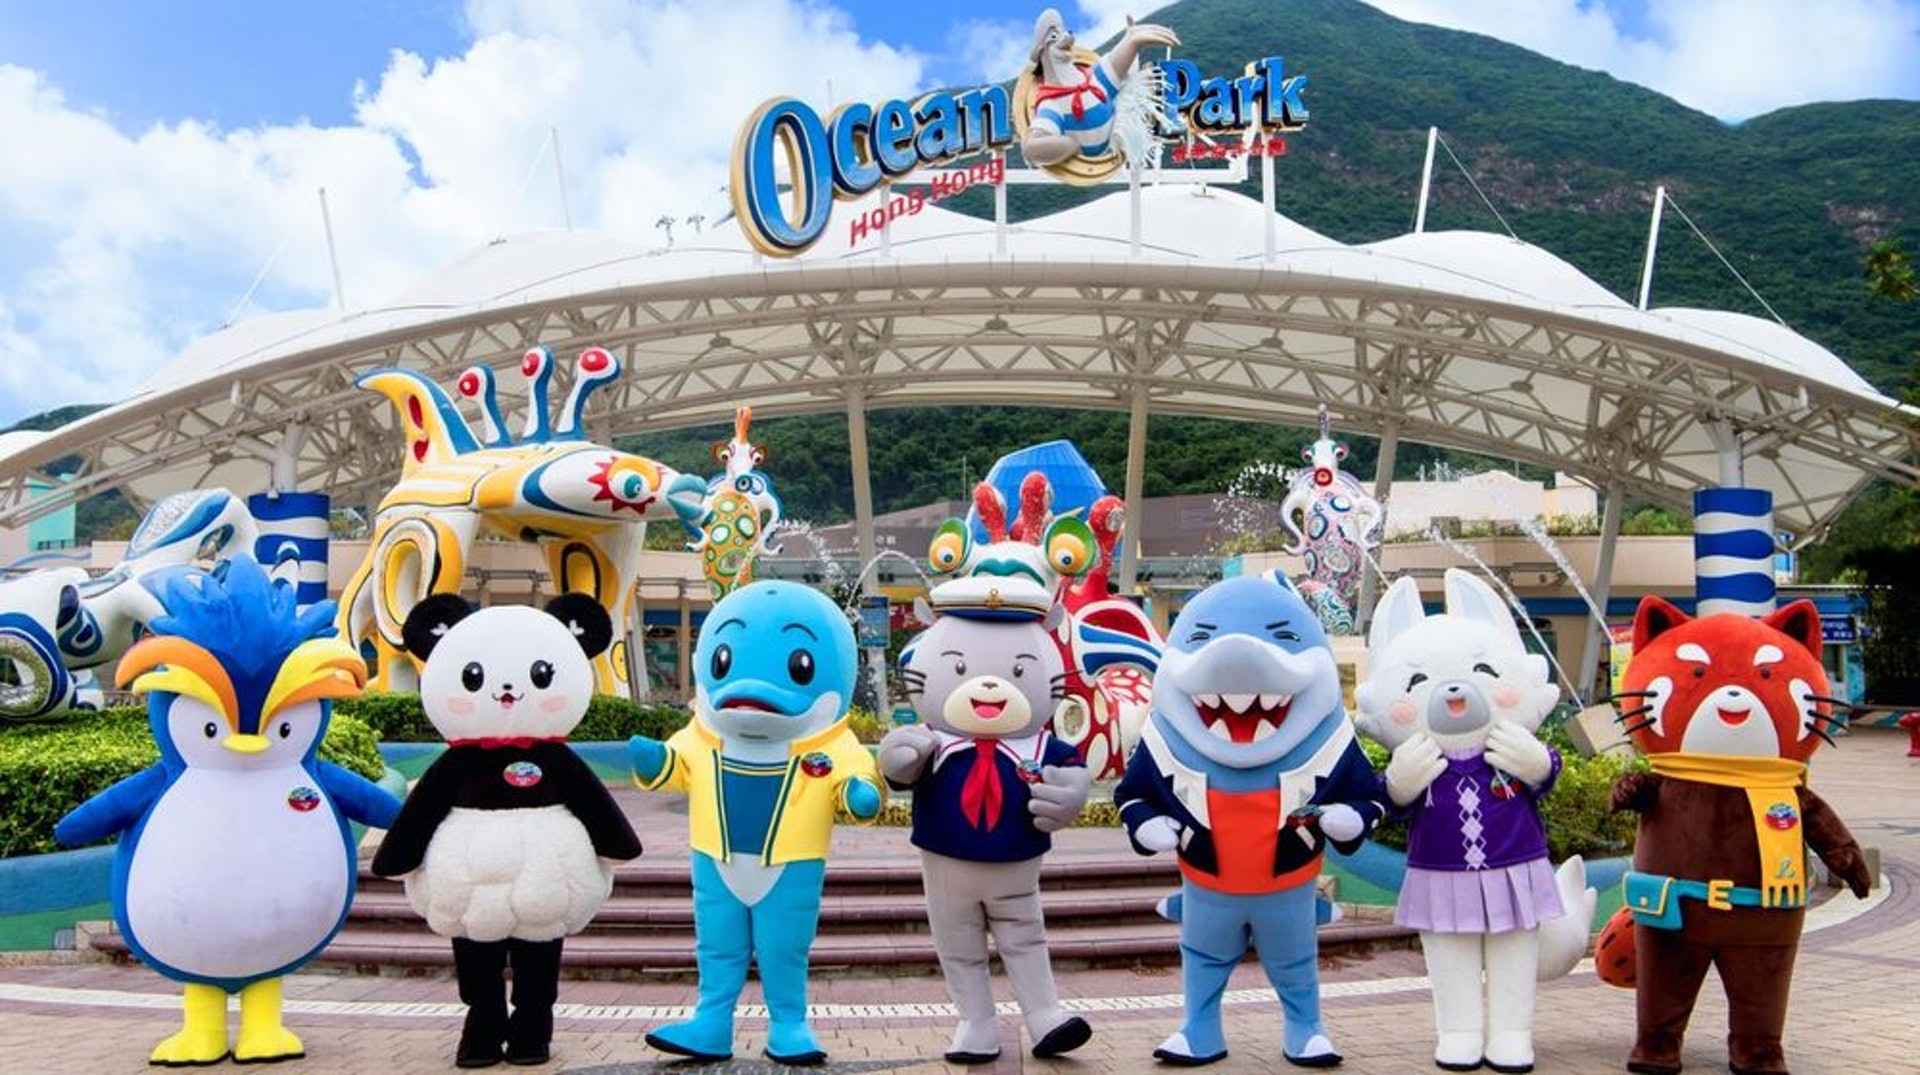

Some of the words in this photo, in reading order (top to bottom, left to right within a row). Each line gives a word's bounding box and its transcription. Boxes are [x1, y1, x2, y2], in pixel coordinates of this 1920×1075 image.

[733, 83, 1011, 255] Ocean
[1157, 56, 1310, 134] Park
[850, 186, 925, 247] Hong
[931, 157, 1004, 200] Kong
